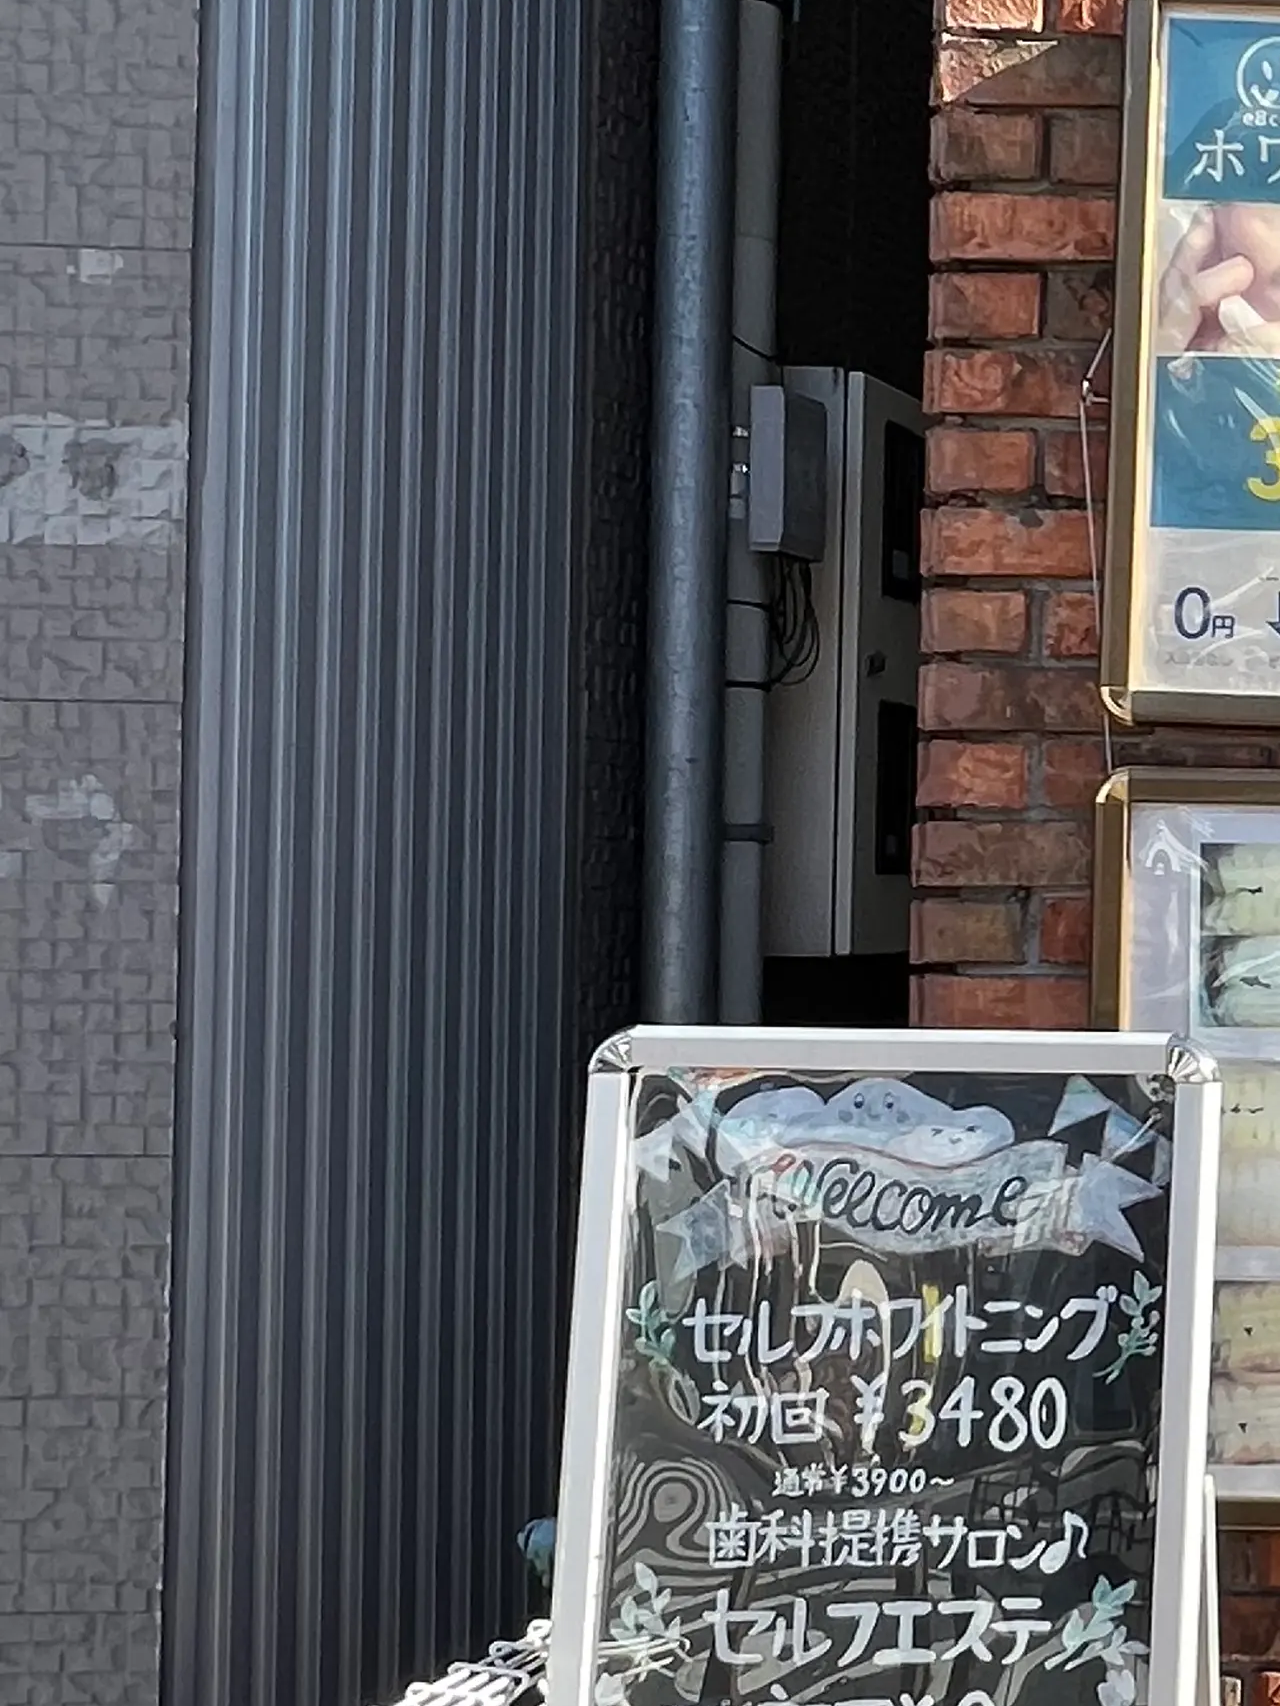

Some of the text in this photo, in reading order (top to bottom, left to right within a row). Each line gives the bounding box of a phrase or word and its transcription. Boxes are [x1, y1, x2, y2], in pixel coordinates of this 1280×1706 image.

[1174, 586, 1235, 640] 0円
[772, 1155, 1030, 1233] Welcome
[683, 1285, 1117, 1363] セルフホワイトニング
[702, 1588, 1052, 1668] セルフエステ
